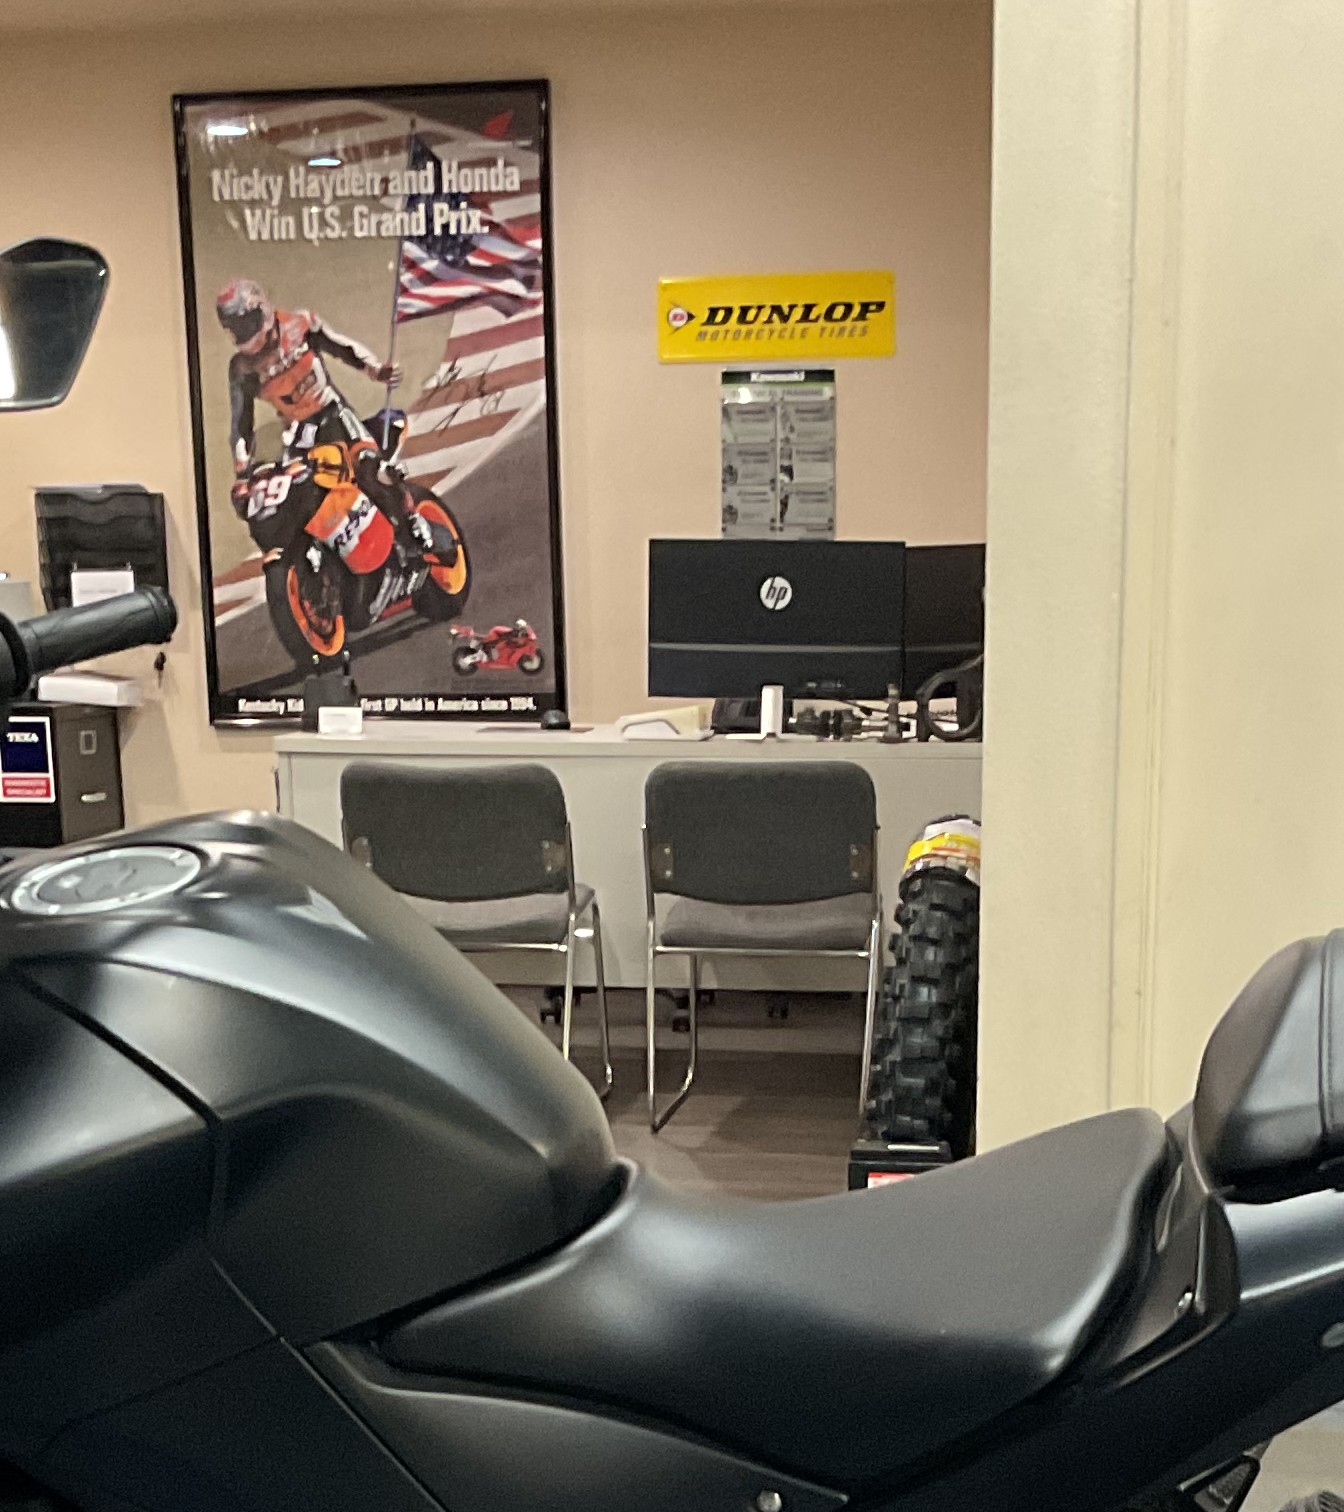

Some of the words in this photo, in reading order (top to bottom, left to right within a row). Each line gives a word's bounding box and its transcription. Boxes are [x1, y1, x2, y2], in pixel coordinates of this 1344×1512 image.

[211, 167, 283, 201] Nicky
[289, 164, 380, 201] Hayden
[389, 164, 435, 195] and
[441, 158, 520, 194] Honda
[244, 207, 295, 241] Win
[301, 206, 348, 241] U.S.
[353, 203, 426, 238] Grand
[433, 202, 490, 236] Prix.
[701, 301, 886, 327] DUNLOP
[695, 326, 810, 342] MOTORCYCLE
[819, 324, 869, 339] TIRES
[763, 576, 790, 610] hp
